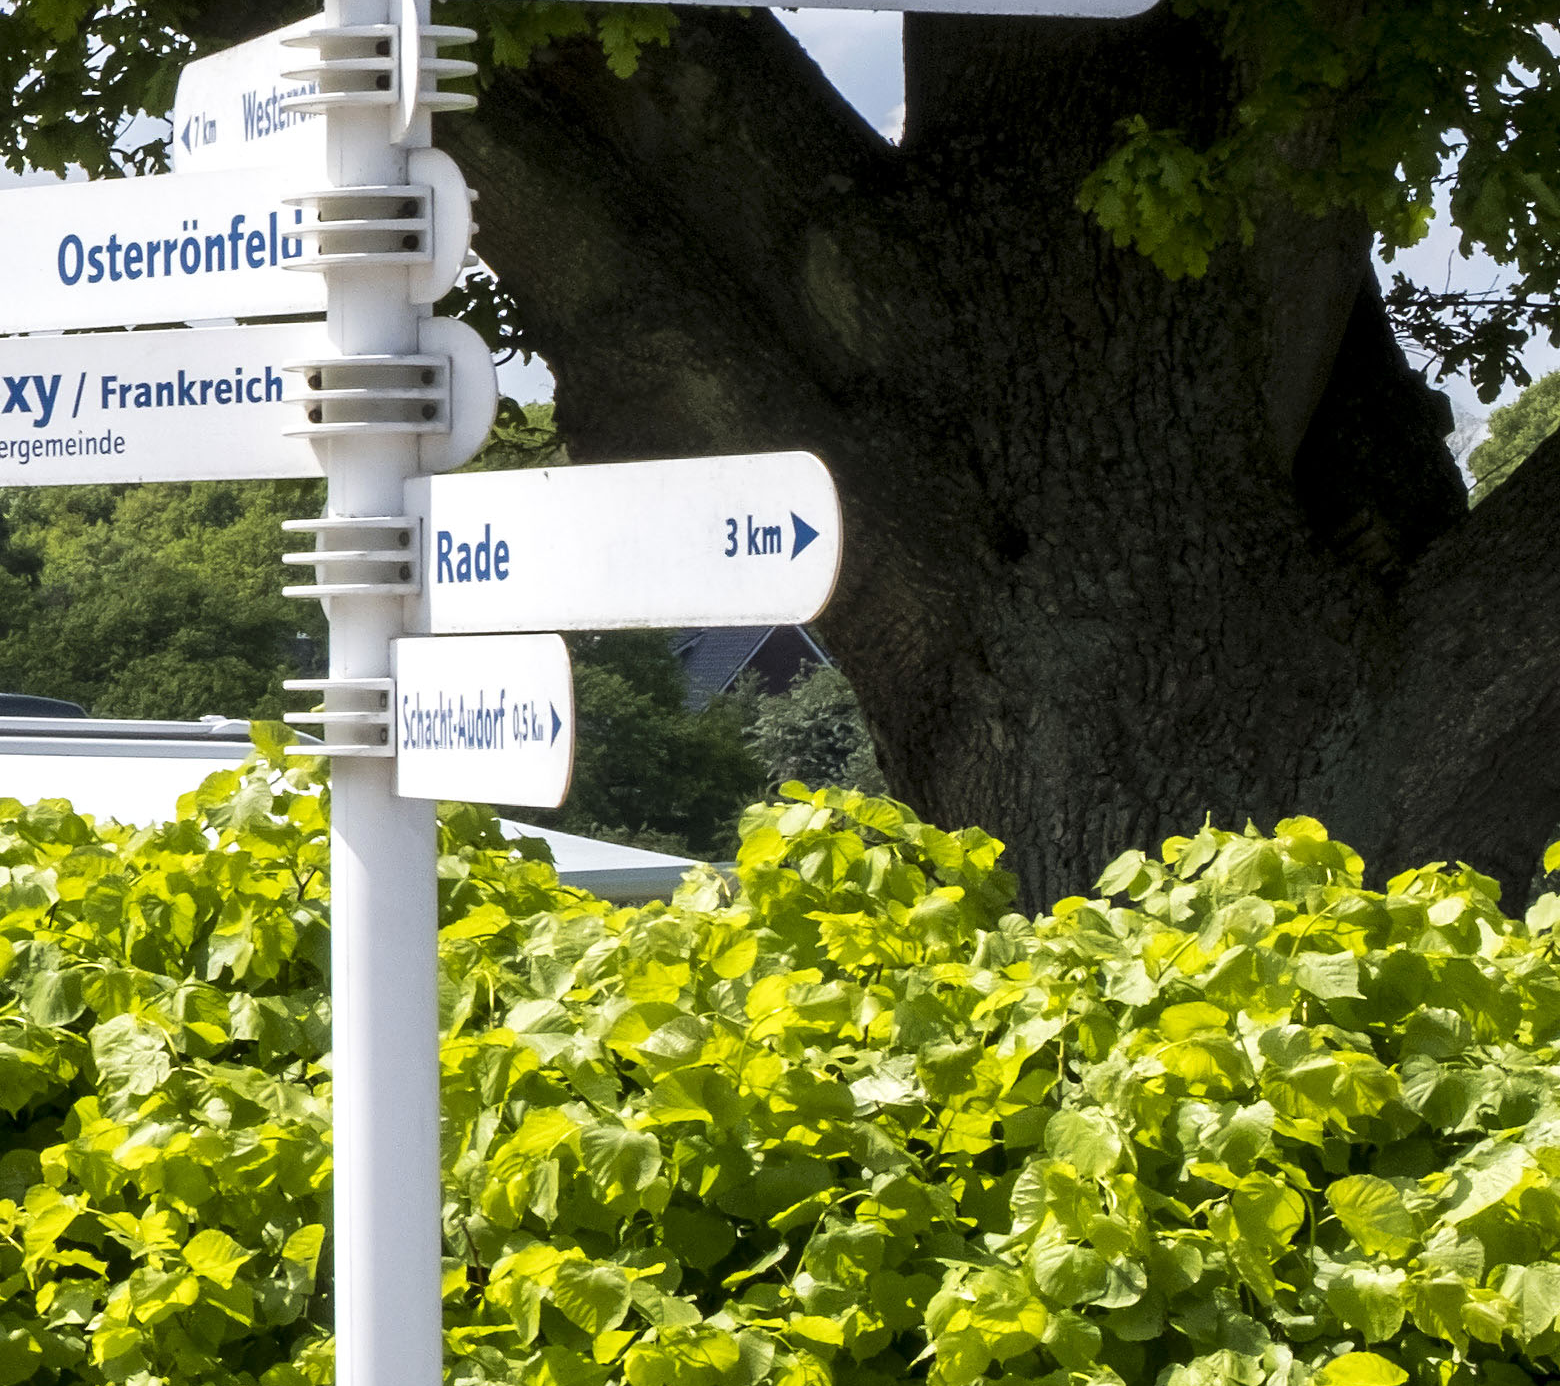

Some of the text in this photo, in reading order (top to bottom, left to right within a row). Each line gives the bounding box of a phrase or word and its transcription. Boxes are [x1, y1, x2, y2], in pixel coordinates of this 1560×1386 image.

[203, 111, 217, 144] km
[57, 205, 303, 287] Osterrönfeld
[72, 371, 87, 419] /
[102, 365, 284, 411] Frankreich
[437, 514, 782, 584] Rade 3 km
[403, 688, 506, 750] Schacht-Audorf
